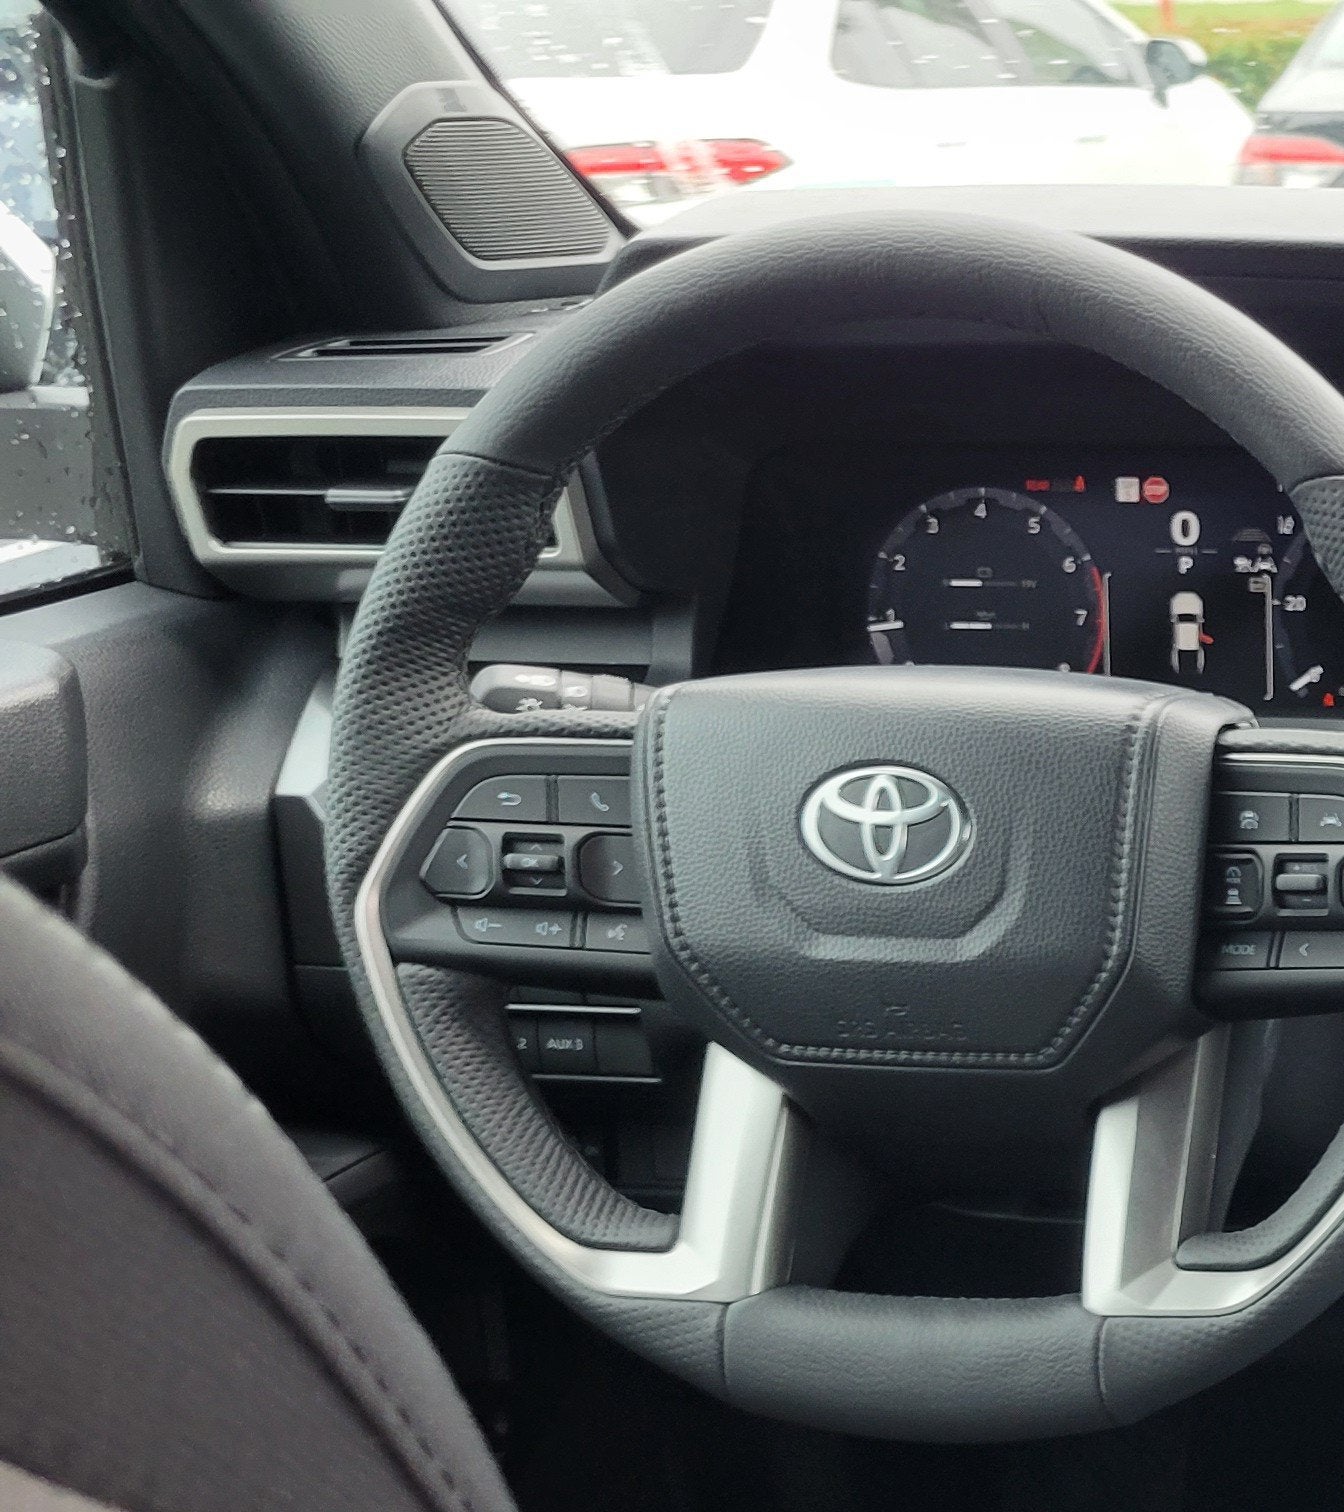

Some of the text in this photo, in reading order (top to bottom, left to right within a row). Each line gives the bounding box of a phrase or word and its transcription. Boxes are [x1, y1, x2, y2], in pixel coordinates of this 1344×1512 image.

[974, 503, 988, 519] 4
[926, 516, 940, 534] 3
[1027, 516, 1041, 534] 5
[1170, 510, 1200, 547] 0
[893, 553, 906, 571] 2
[1062, 556, 1076, 573] 6
[1177, 555, 1194, 574] P
[1073, 608, 1088, 626] 7
[546, 1038, 573, 1050] AUX
